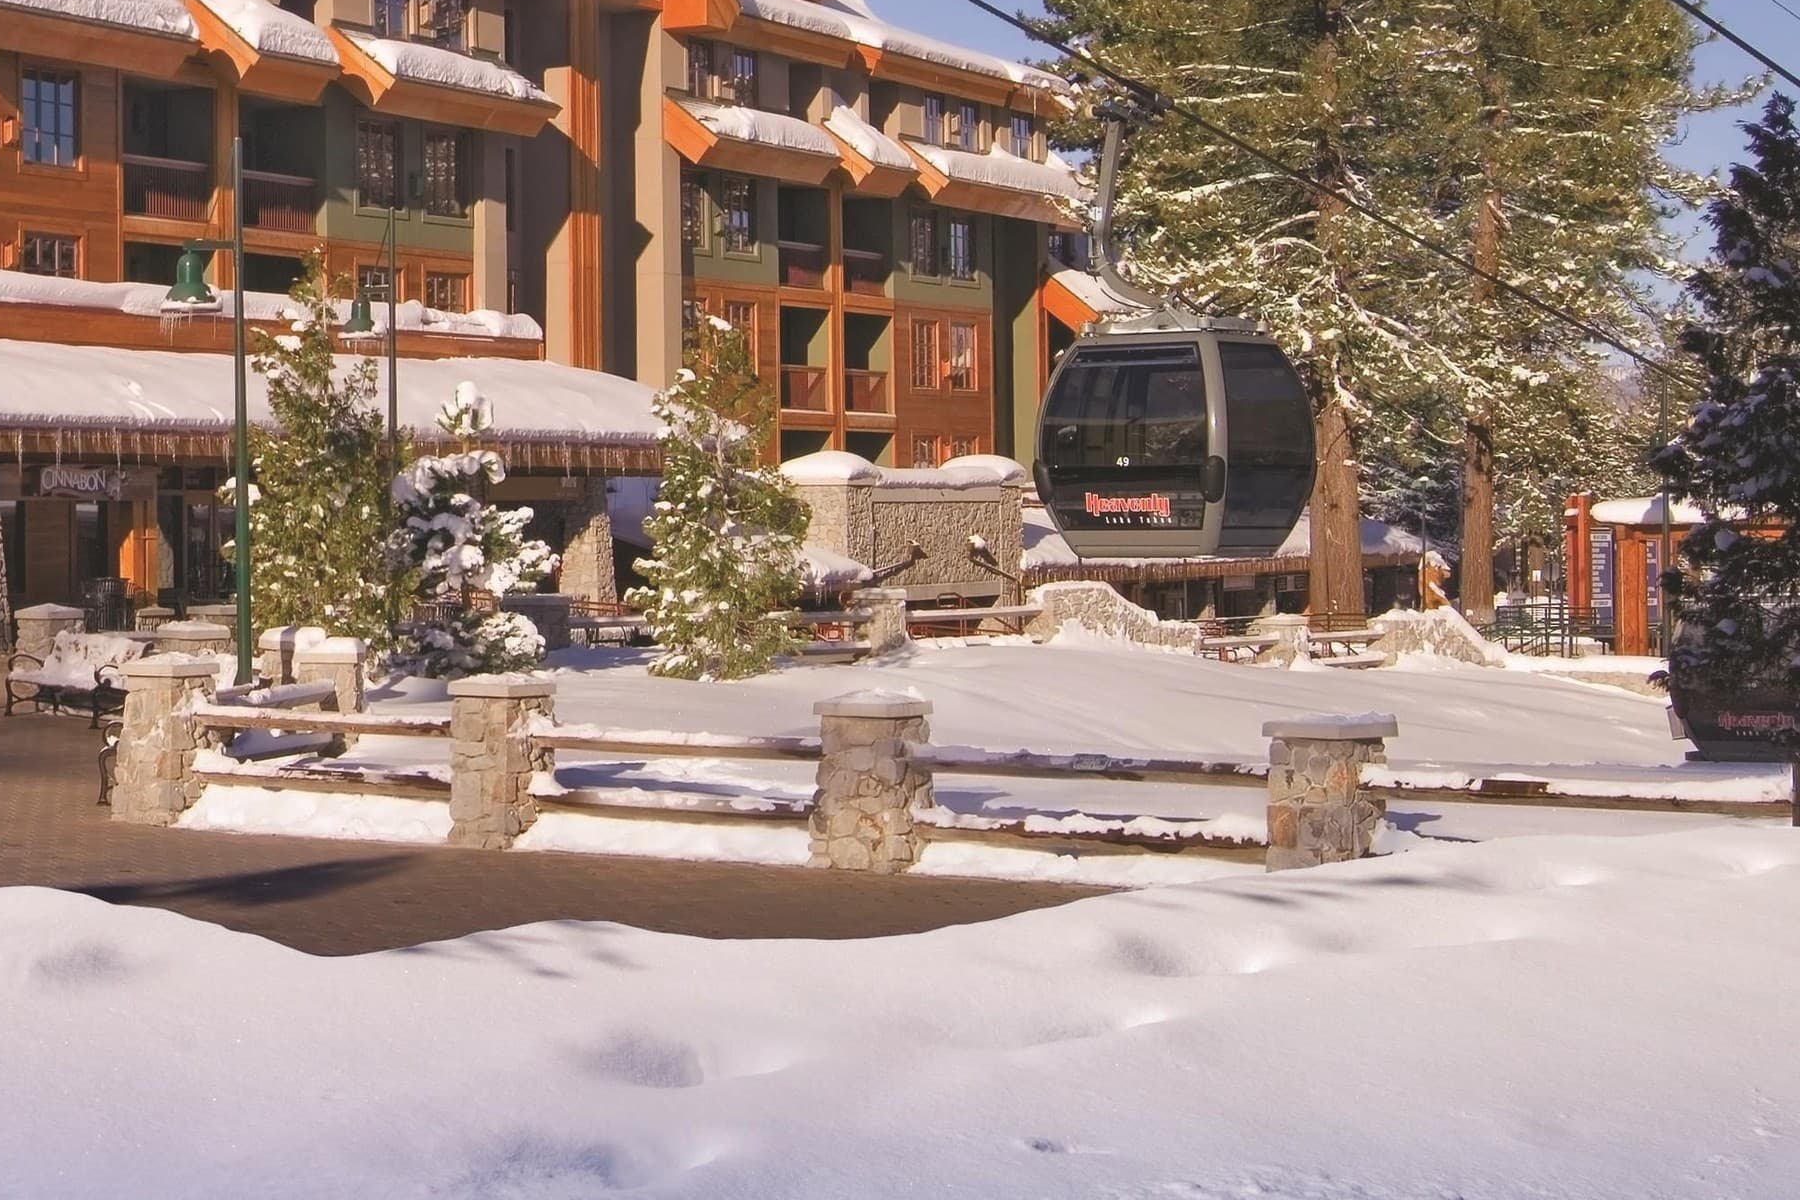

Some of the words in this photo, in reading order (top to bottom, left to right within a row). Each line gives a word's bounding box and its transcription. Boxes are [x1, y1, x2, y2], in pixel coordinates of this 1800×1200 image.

[1116, 456, 1130, 467] 49
[41, 469, 106, 491] CINNABON
[1085, 492, 1171, 517] Heavenly
